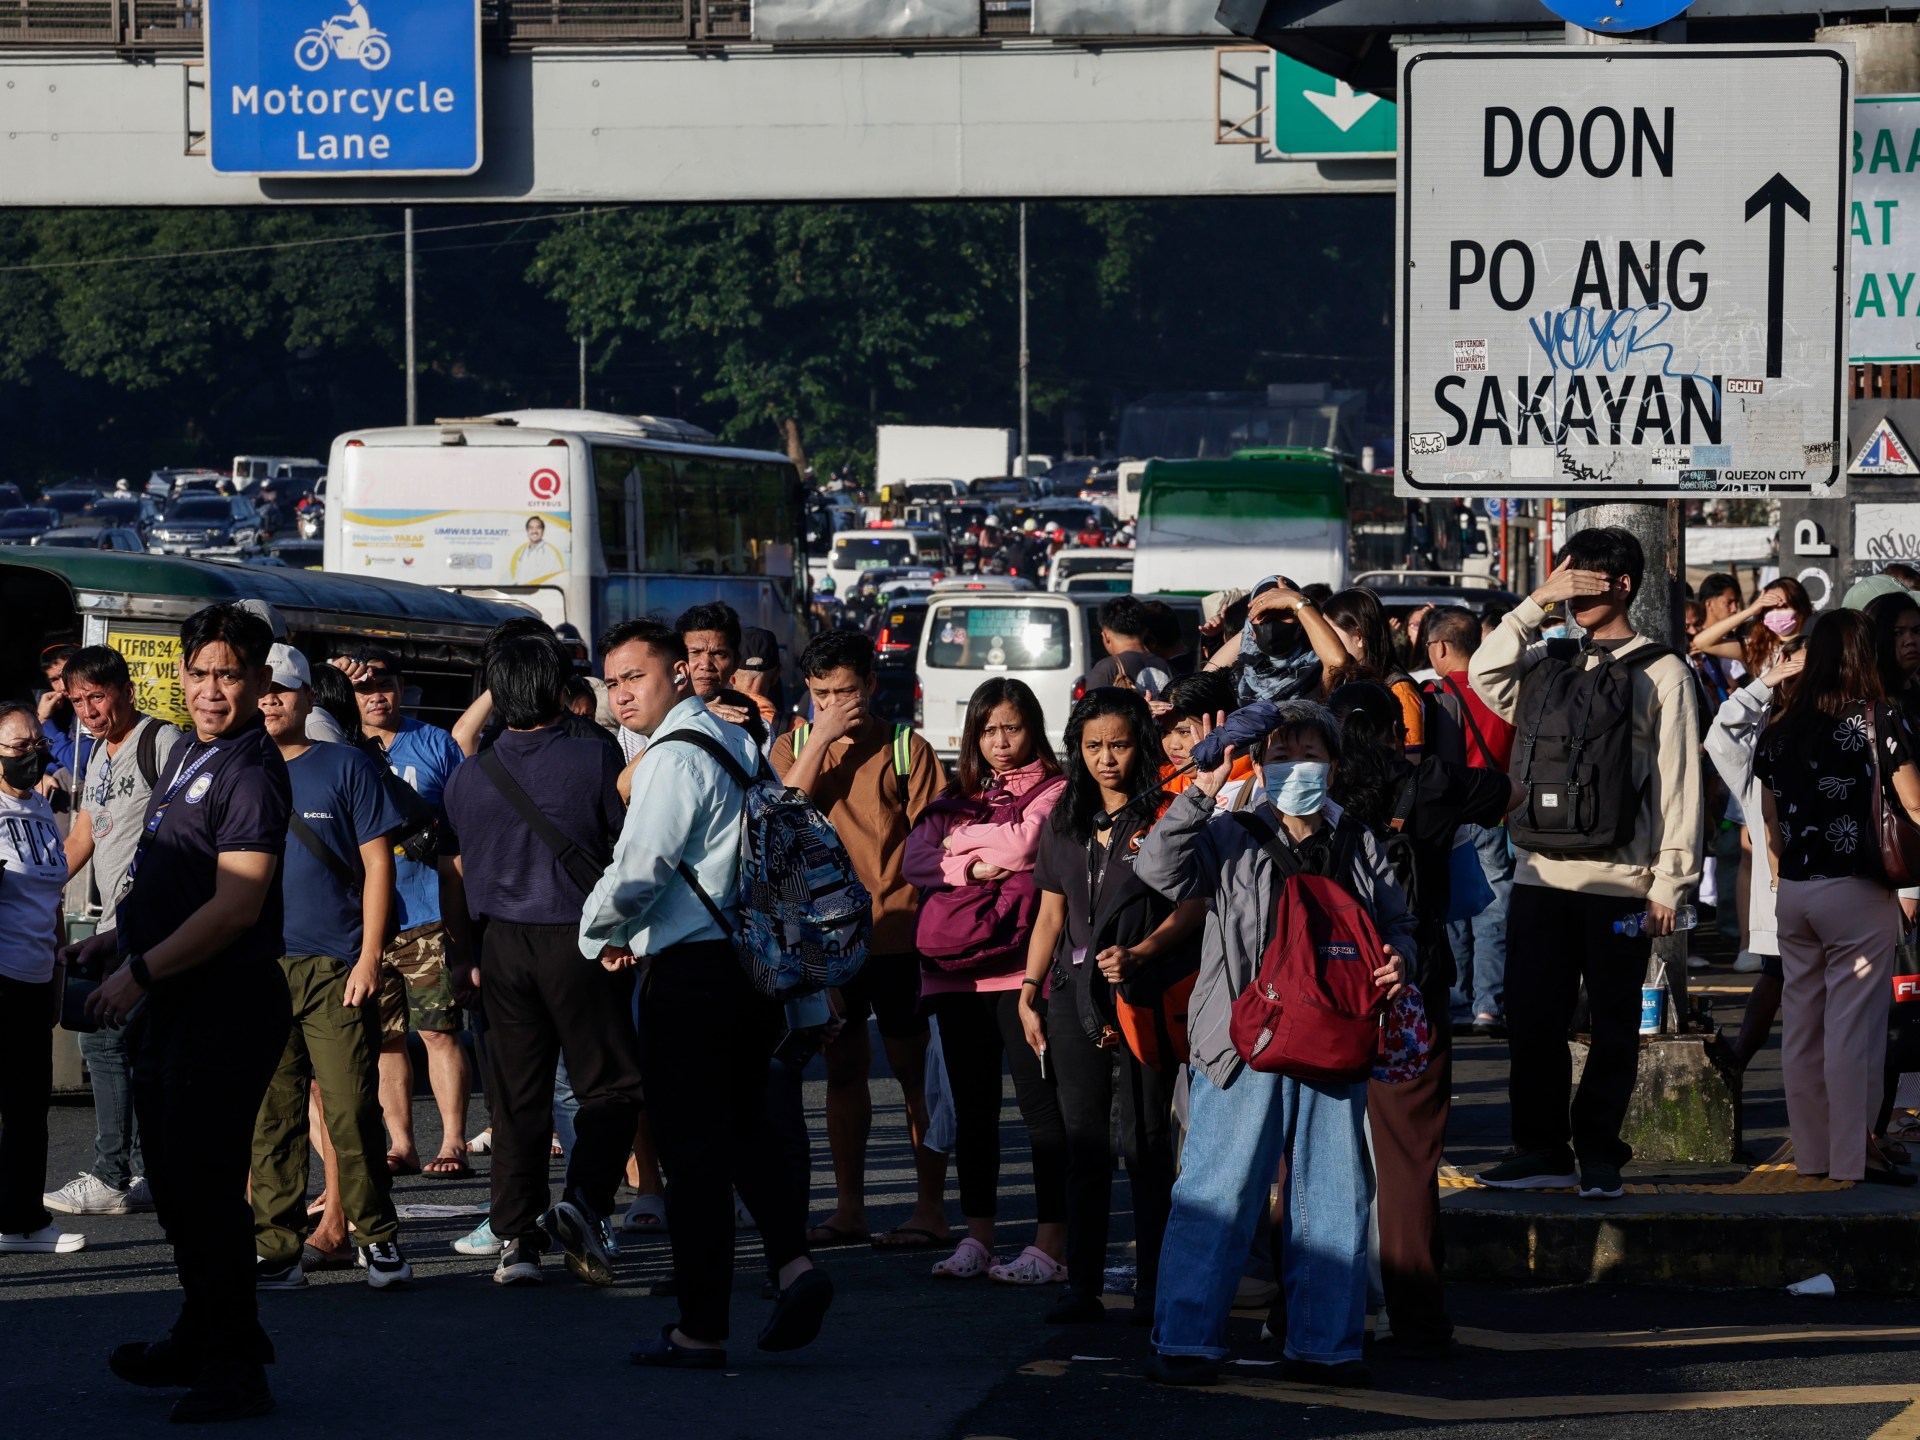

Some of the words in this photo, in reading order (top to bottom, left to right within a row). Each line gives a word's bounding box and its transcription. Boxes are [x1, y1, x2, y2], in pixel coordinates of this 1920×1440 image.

[232, 81, 454, 121] Motorcycle
[297, 130, 390, 160] Lane
[1483, 105, 1675, 178] DOON
[1449, 239, 1535, 311] PO
[1569, 239, 1709, 311] ANG
[1456, 363, 1486, 371] FILIPINAS
[1727, 380, 1762, 393] GCULT
[1434, 374, 1722, 446] SAKAYAN
[1725, 470, 1775, 480] QUEZON
[1779, 470, 1806, 480] CITY
[118, 639, 156, 658] LTFRB
